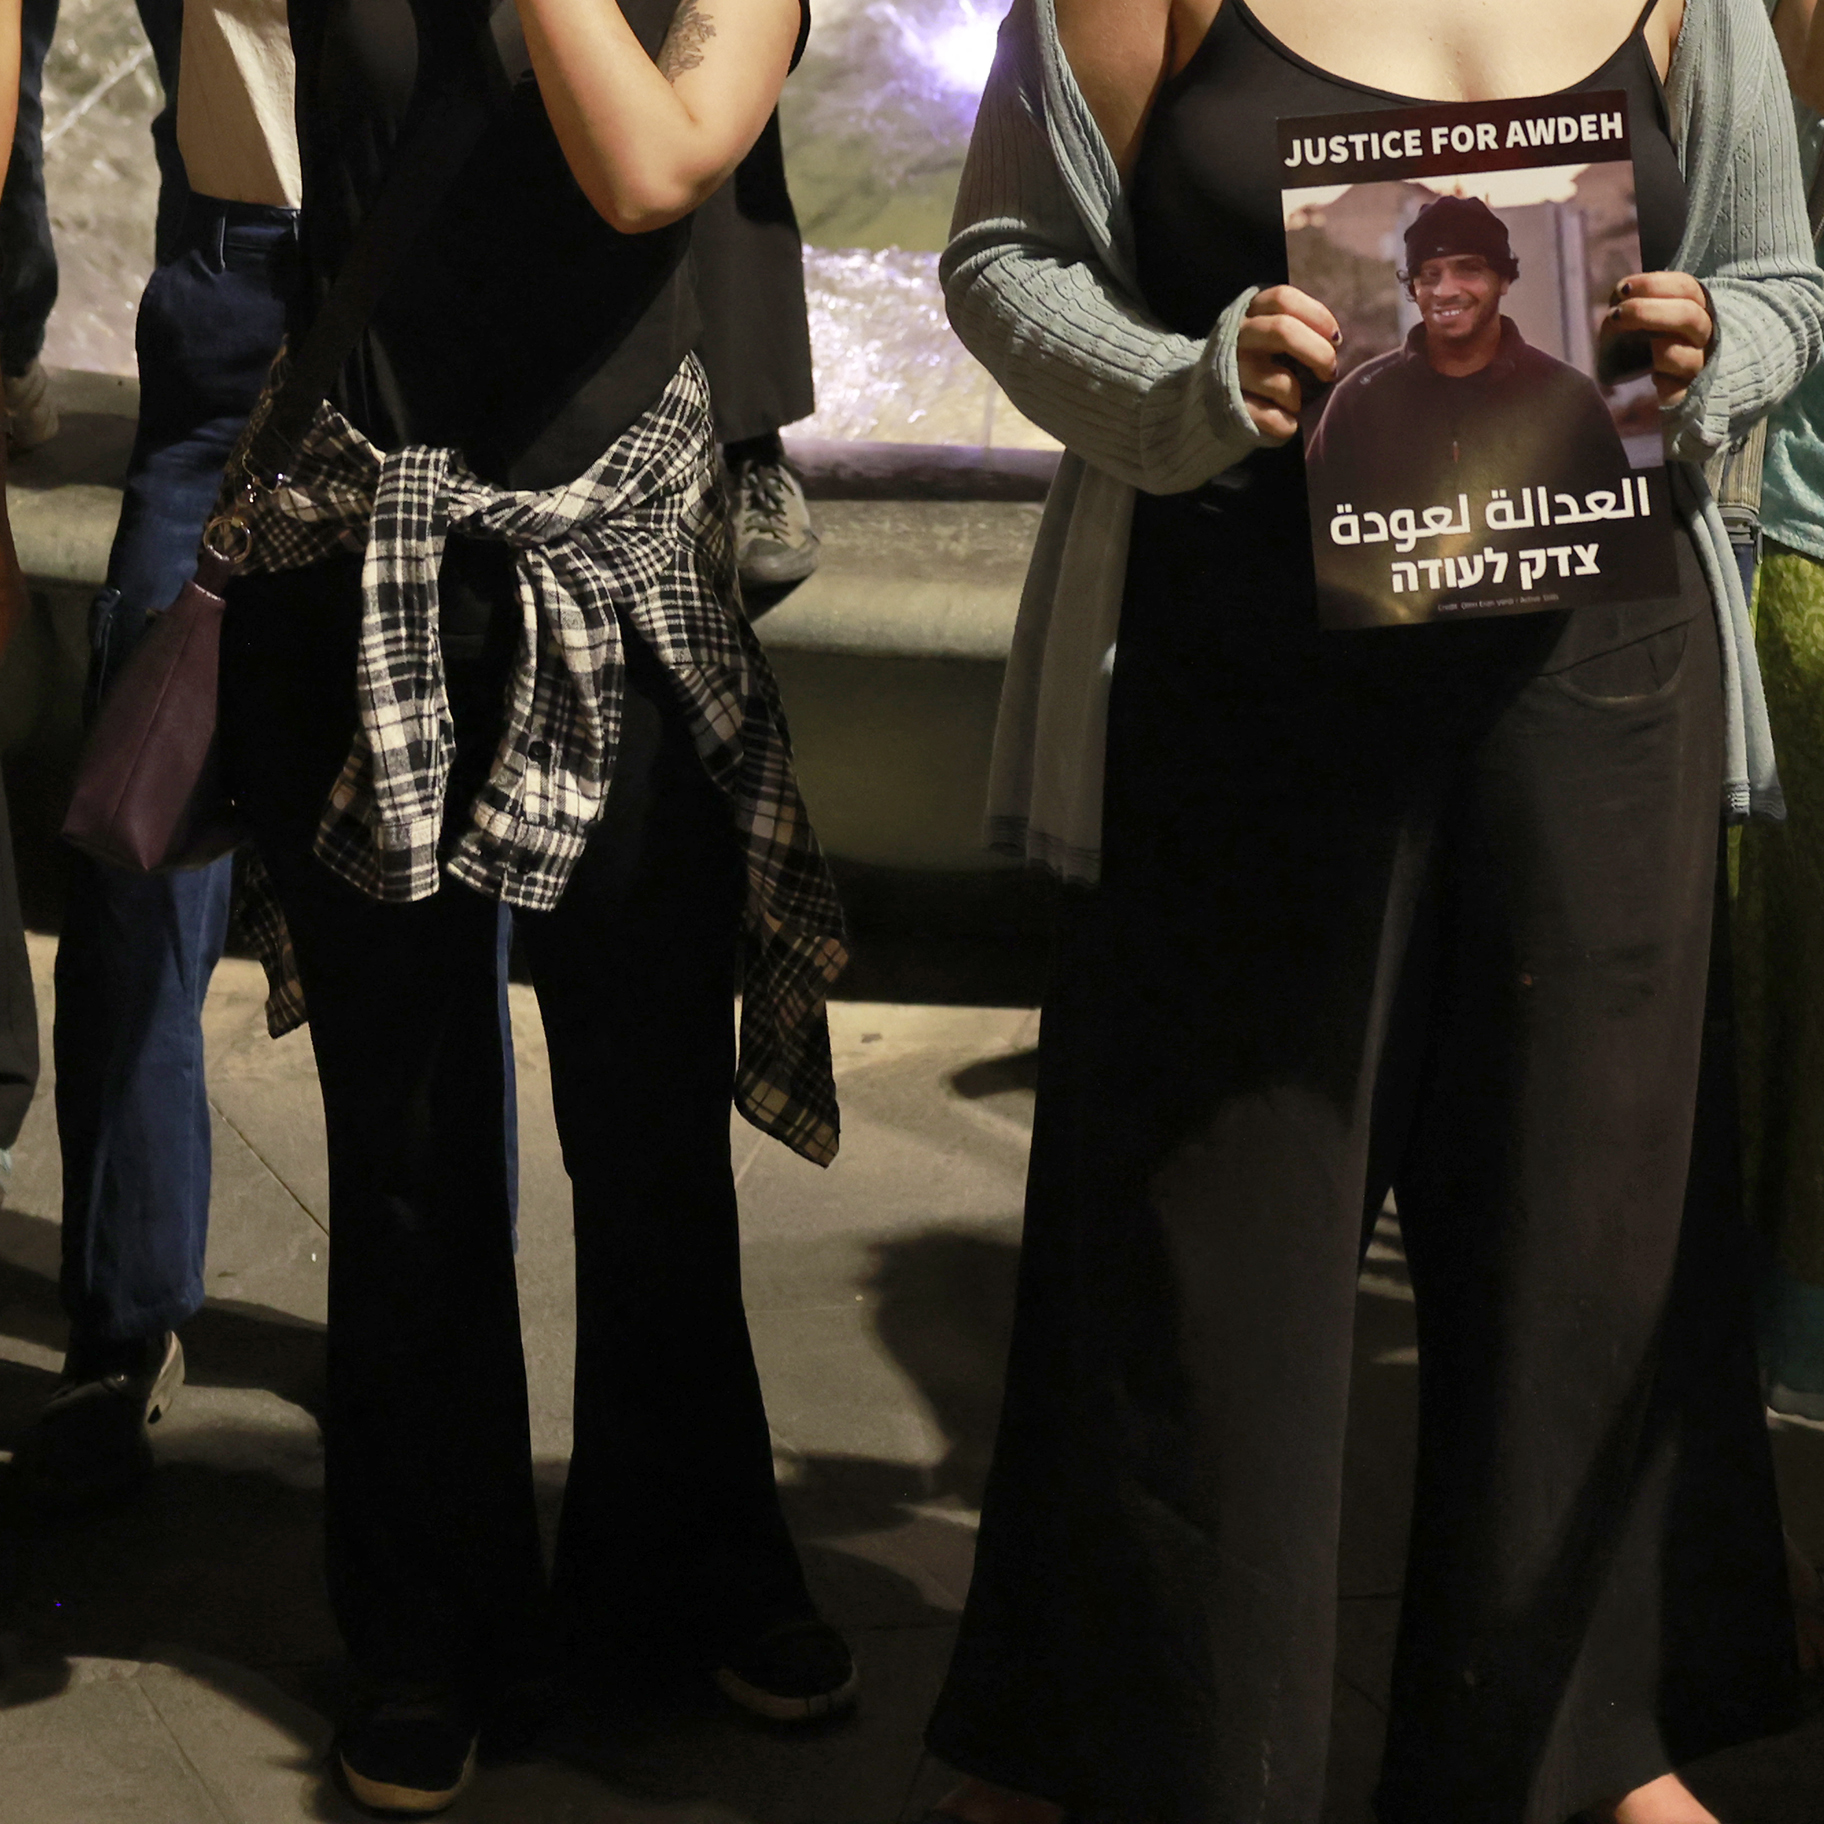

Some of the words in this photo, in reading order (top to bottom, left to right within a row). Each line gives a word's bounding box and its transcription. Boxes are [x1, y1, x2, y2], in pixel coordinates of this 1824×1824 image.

[1283, 127, 1423, 168] JUSTICE
[1431, 121, 1500, 155] FOR
[1505, 111, 1625, 149] AWDEH
[1329, 492, 1472, 553] لعودة
[1484, 475, 1652, 531] العدالة
[1391, 545, 1508, 594] לעודה
[1518, 542, 1602, 591] צדק
